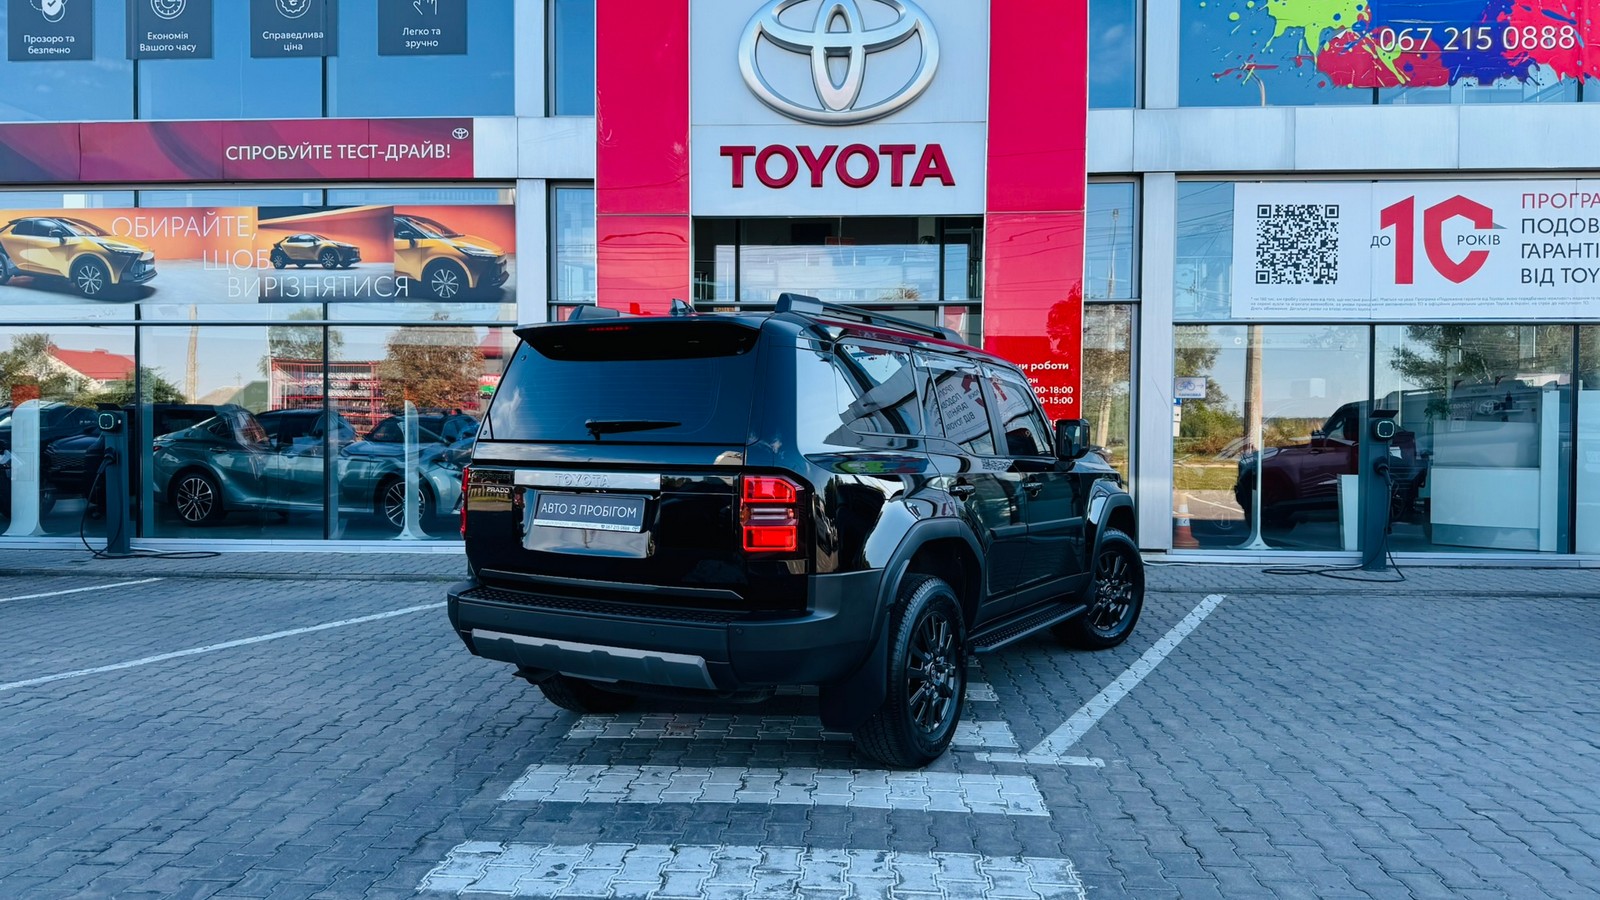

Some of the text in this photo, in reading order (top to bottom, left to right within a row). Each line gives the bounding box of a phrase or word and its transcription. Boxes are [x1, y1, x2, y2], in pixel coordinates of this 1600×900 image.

[147, 31, 189, 41] Економія
[262, 30, 324, 40] Справедлива
[402, 27, 429, 36] Легко
[1380, 25, 1576, 51] 067 215 0888
[23, 35, 75, 44] Прозоро та
[283, 42, 303, 51] ціна
[405, 39, 439, 49] зручно
[28, 45, 71, 54] безпечно
[140, 43, 197, 53] Вашого часу
[225, 141, 451, 161] СПРОБУЙТЕ ТЕСТ-ДРАЙВ!
[720, 143, 956, 189] TOYOTA
[1521, 192, 1600, 209] ПРОГРА
[111, 211, 257, 240] ОБИРАЙТЕ,
[1521, 217, 1600, 237] ПОДОВ
[1370, 235, 1391, 249] ДО
[1457, 234, 1501, 246] РОКІВ
[1521, 242, 1600, 259] ГАРАНТІ
[203, 249, 271, 274] ЩОБ
[1521, 267, 1600, 287] ВІД TOY
[228, 276, 408, 298] ВИРІЗНЯТИСЯ
[1030, 360, 1069, 372] роботи
[1033, 386, 1074, 394] 00-18:00
[1039, 396, 1074, 404] 0-15:00
[554, 473, 610, 487] TOYOTA
[486, 486, 510, 494] PRADO
[541, 502, 637, 519] АВТО З ПРОБІГОМ
